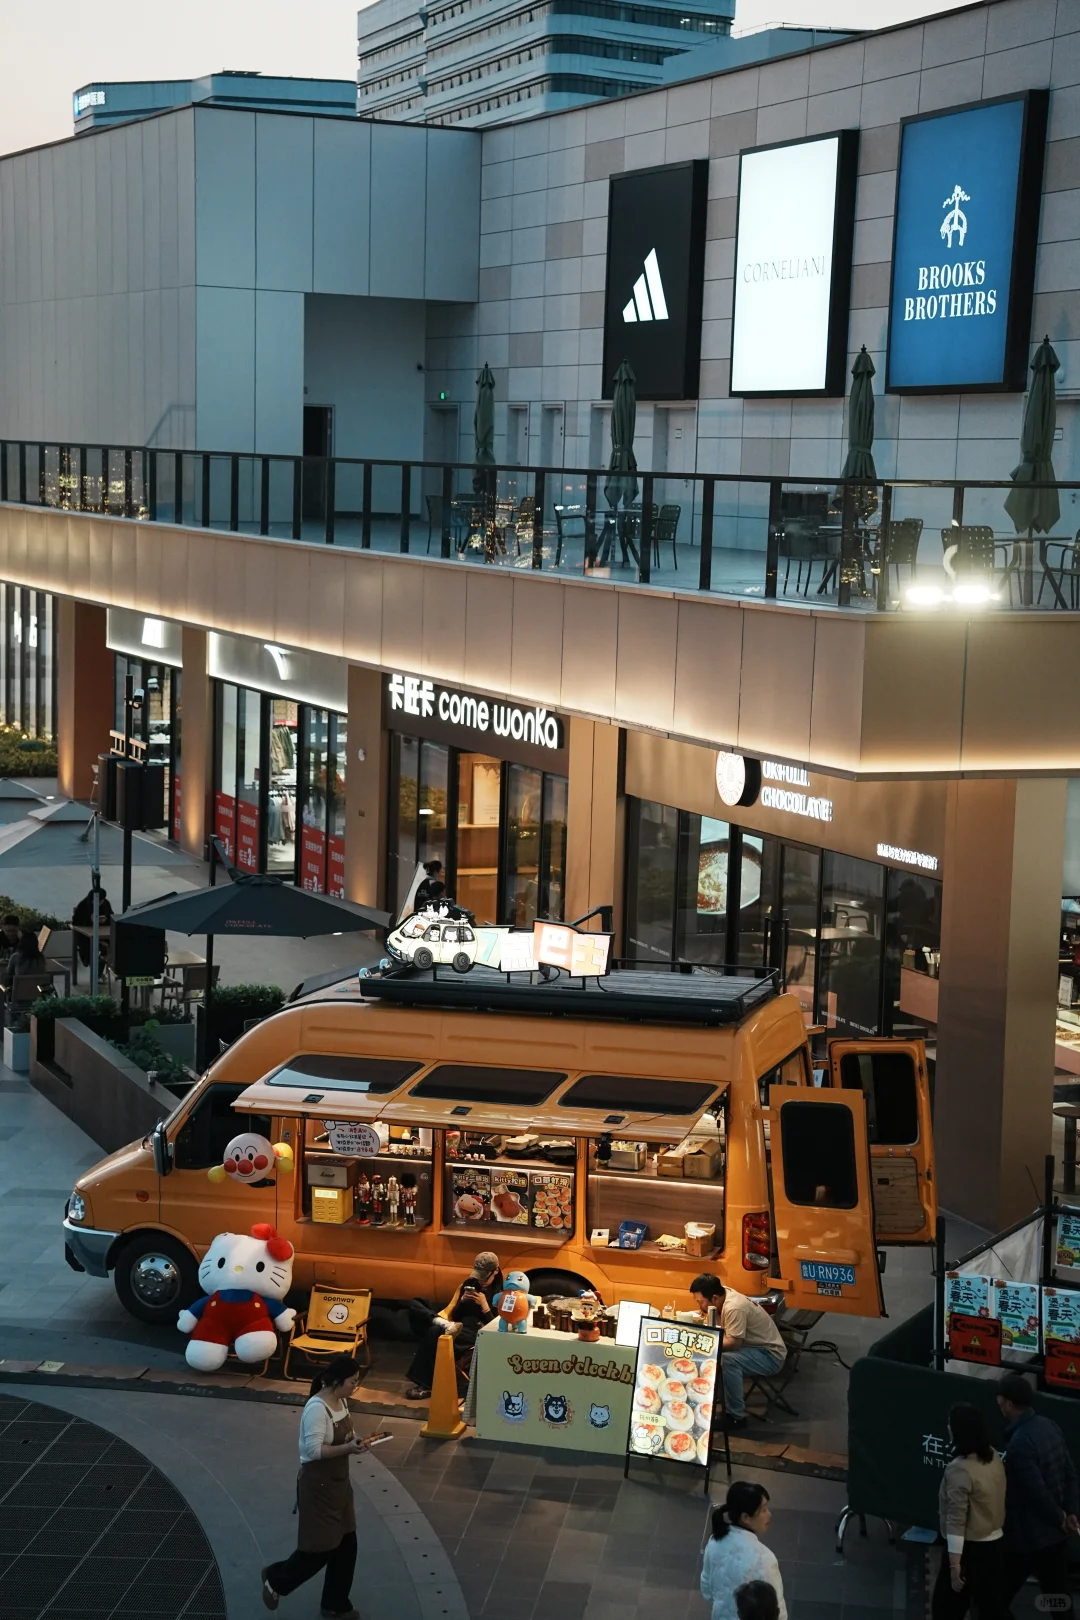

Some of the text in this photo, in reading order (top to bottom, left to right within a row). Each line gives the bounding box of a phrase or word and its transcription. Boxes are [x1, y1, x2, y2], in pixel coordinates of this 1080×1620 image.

[743, 256, 824, 283] CORNELIANI
[918, 260, 986, 290] BROOKS
[904, 290, 996, 320] BROTHERS
[439, 691, 489, 731] come
[760, 786, 833, 822] CHOCOLATE
[324, 1296, 356, 1304] openway
[950, 1291, 974, 1304] 春天
[998, 1300, 1022, 1314] 春天
[1048, 1308, 1073, 1321] 春天
[647, 1327, 714, 1352] 口蘑虾滑
[508, 1354, 560, 1374] Seven
[562, 1354, 620, 1380] o'clock
[923, 1456, 934, 1466] IN
